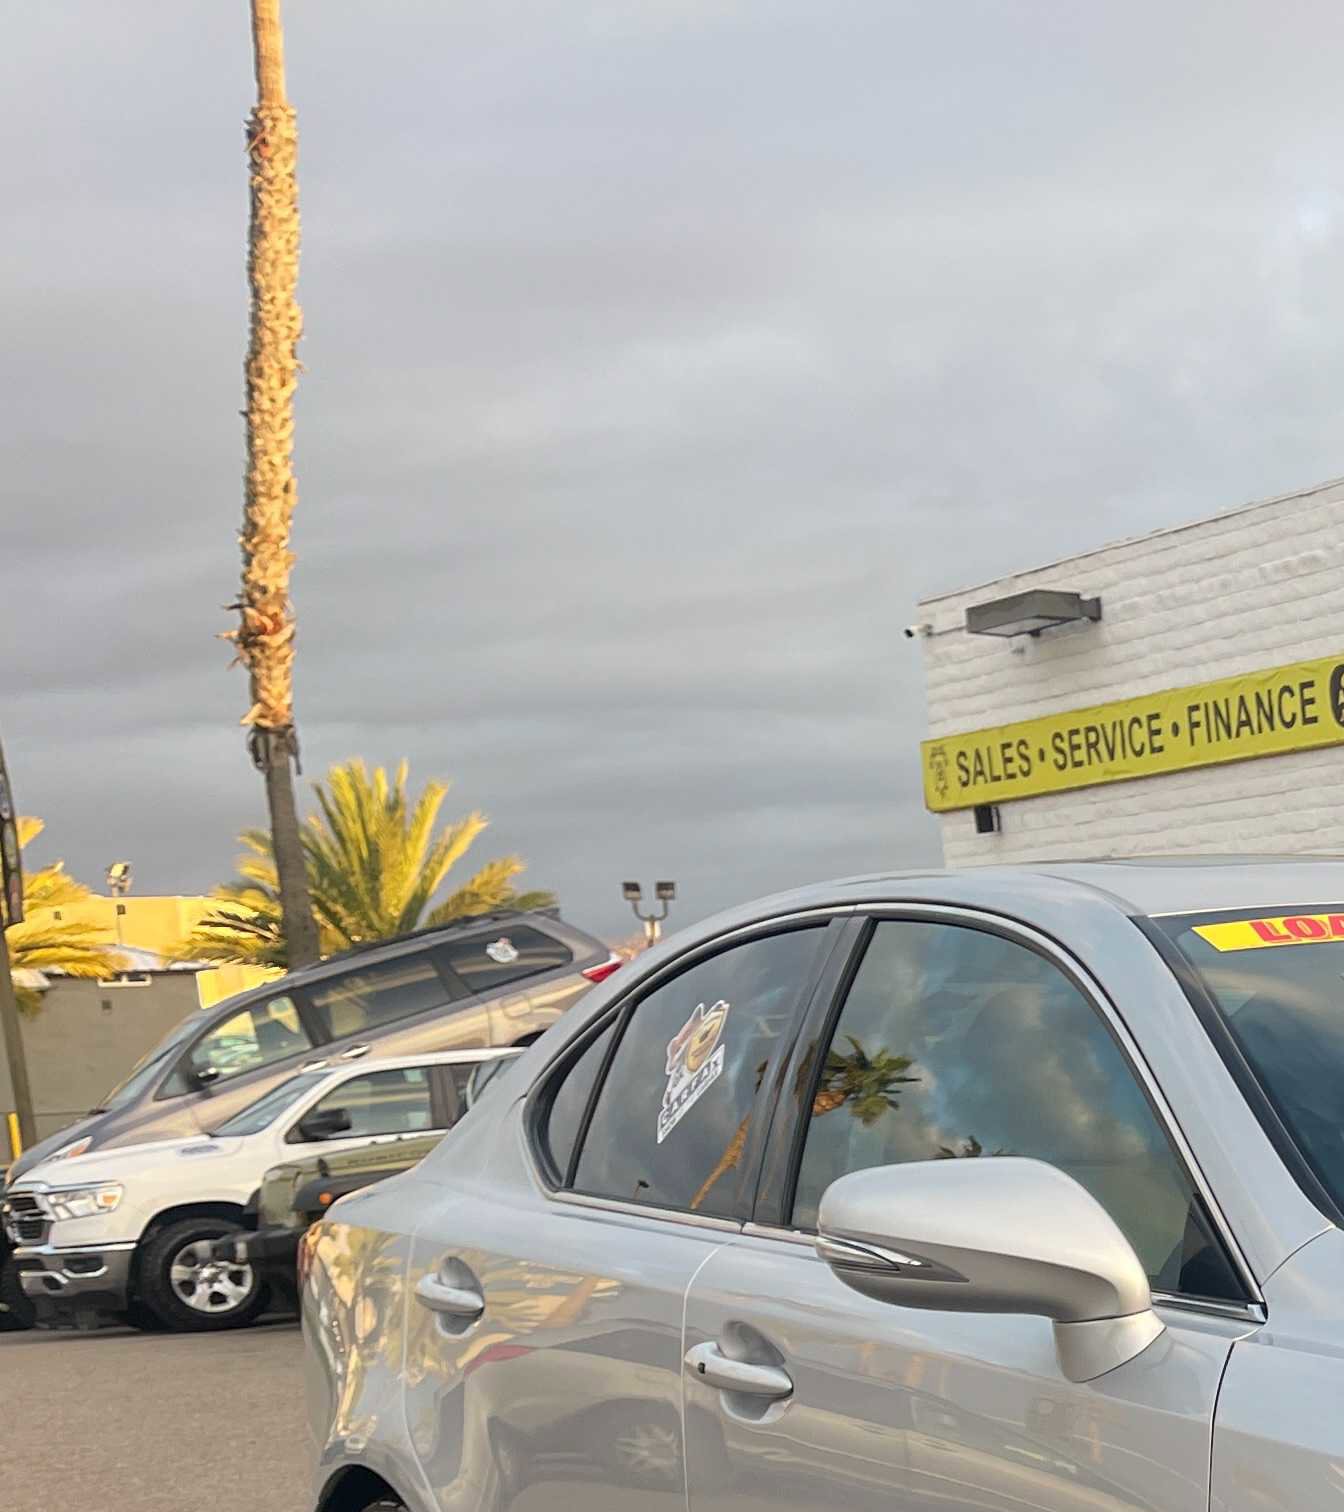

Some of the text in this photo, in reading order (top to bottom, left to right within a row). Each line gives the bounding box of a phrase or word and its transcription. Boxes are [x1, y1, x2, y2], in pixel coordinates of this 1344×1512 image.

[956, 680, 1319, 787] SALES SERVICE FINANCE
